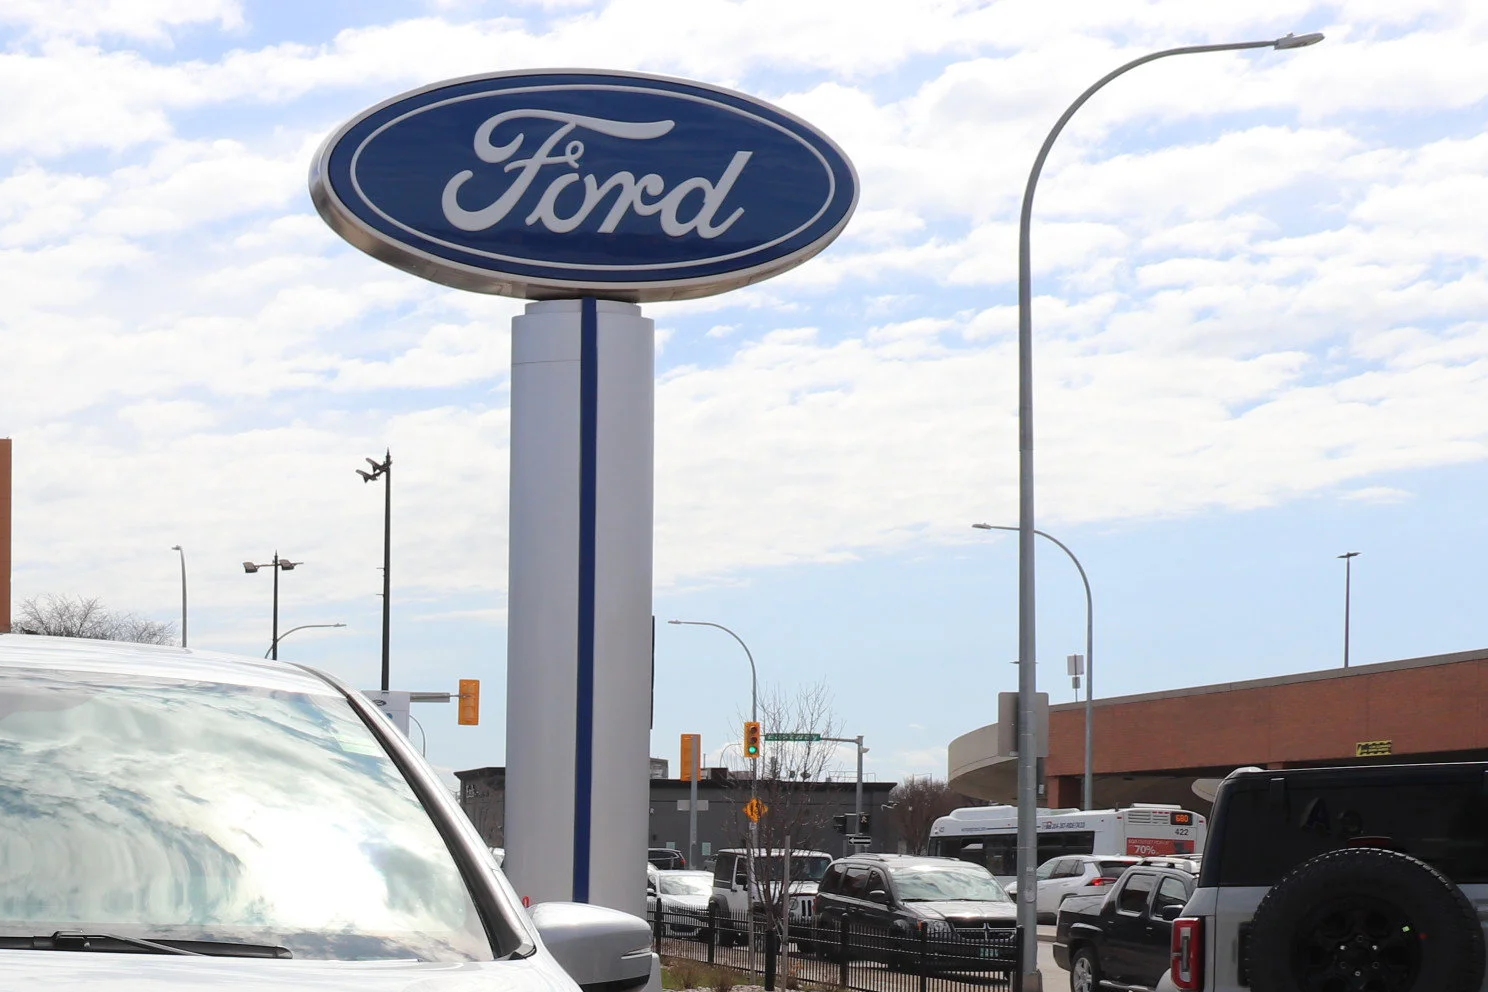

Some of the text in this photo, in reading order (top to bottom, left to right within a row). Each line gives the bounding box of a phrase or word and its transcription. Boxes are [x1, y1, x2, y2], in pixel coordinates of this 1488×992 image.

[442, 109, 754, 239] Ford
[1175, 828, 1189, 836] 422
[1134, 845, 1156, 855] 70%
